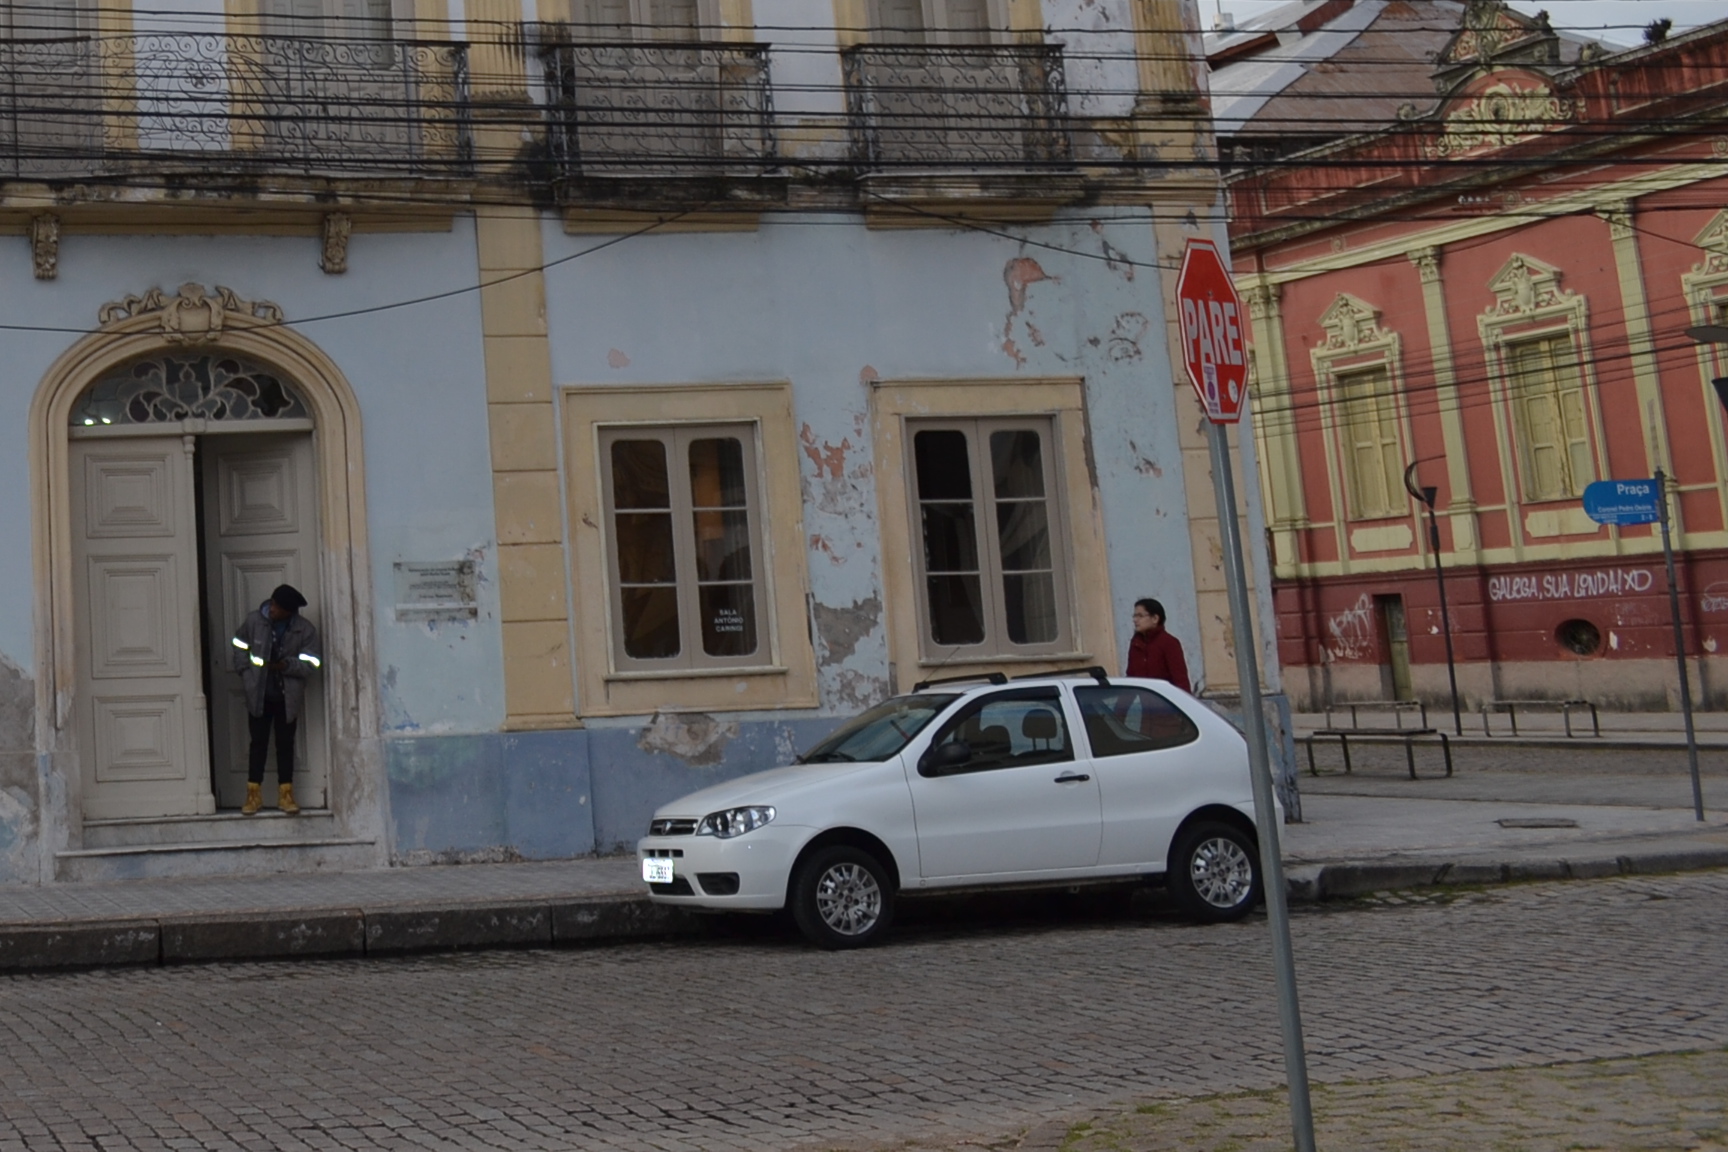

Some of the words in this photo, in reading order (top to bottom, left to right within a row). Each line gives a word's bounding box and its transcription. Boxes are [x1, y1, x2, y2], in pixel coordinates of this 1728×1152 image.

[1183, 298, 1243, 366] PARE
[1617, 483, 1650, 496] Praça
[1543, 573, 1571, 597] SUA
